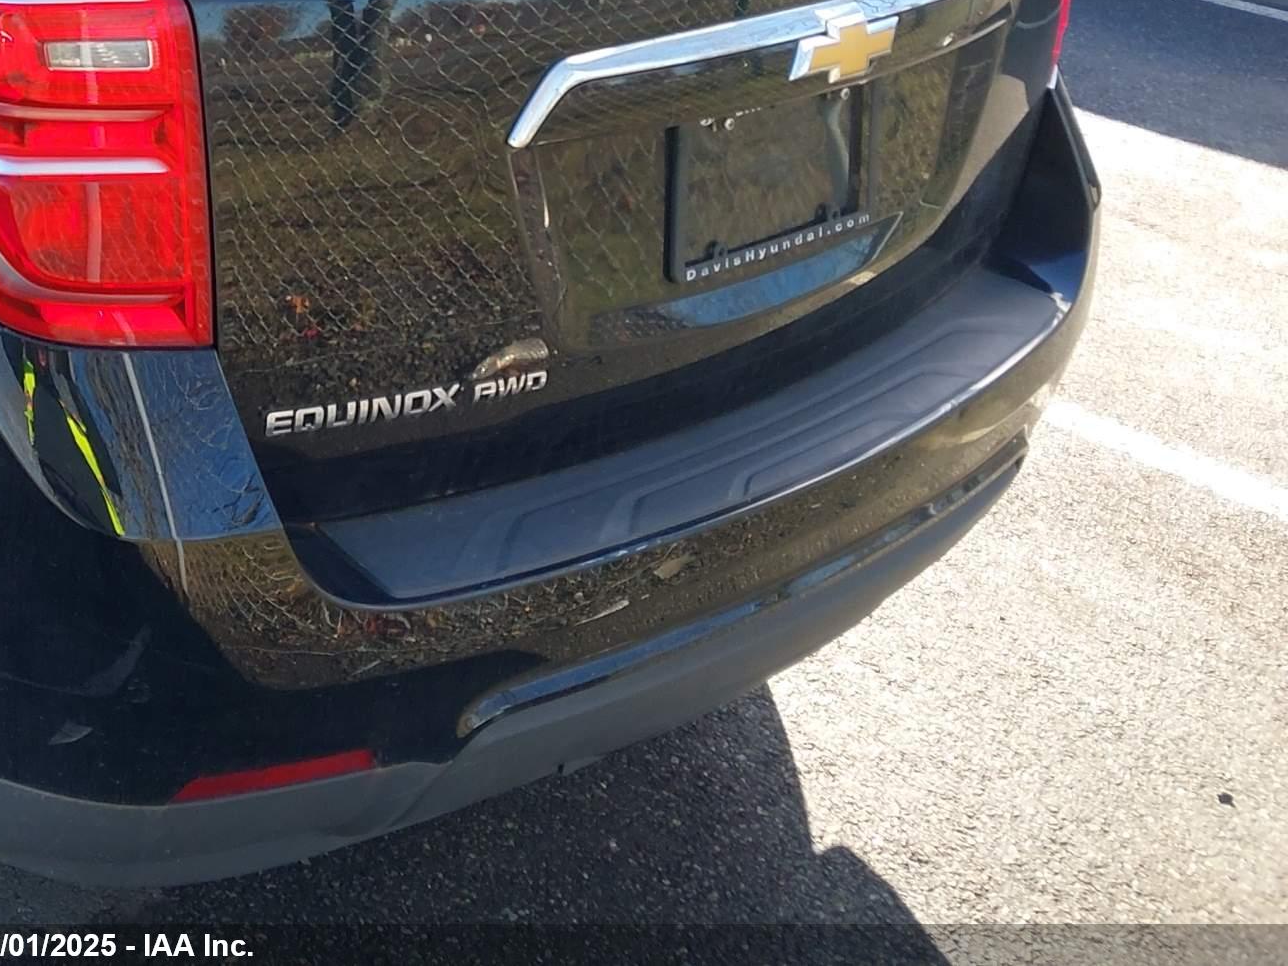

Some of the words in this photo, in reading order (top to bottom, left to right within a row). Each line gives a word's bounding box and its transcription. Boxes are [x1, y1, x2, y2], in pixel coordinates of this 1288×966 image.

[685, 213, 871, 282] DavisHyundai.com
[265, 382, 461, 436] EQUINOX
[473, 370, 548, 403] AWD
